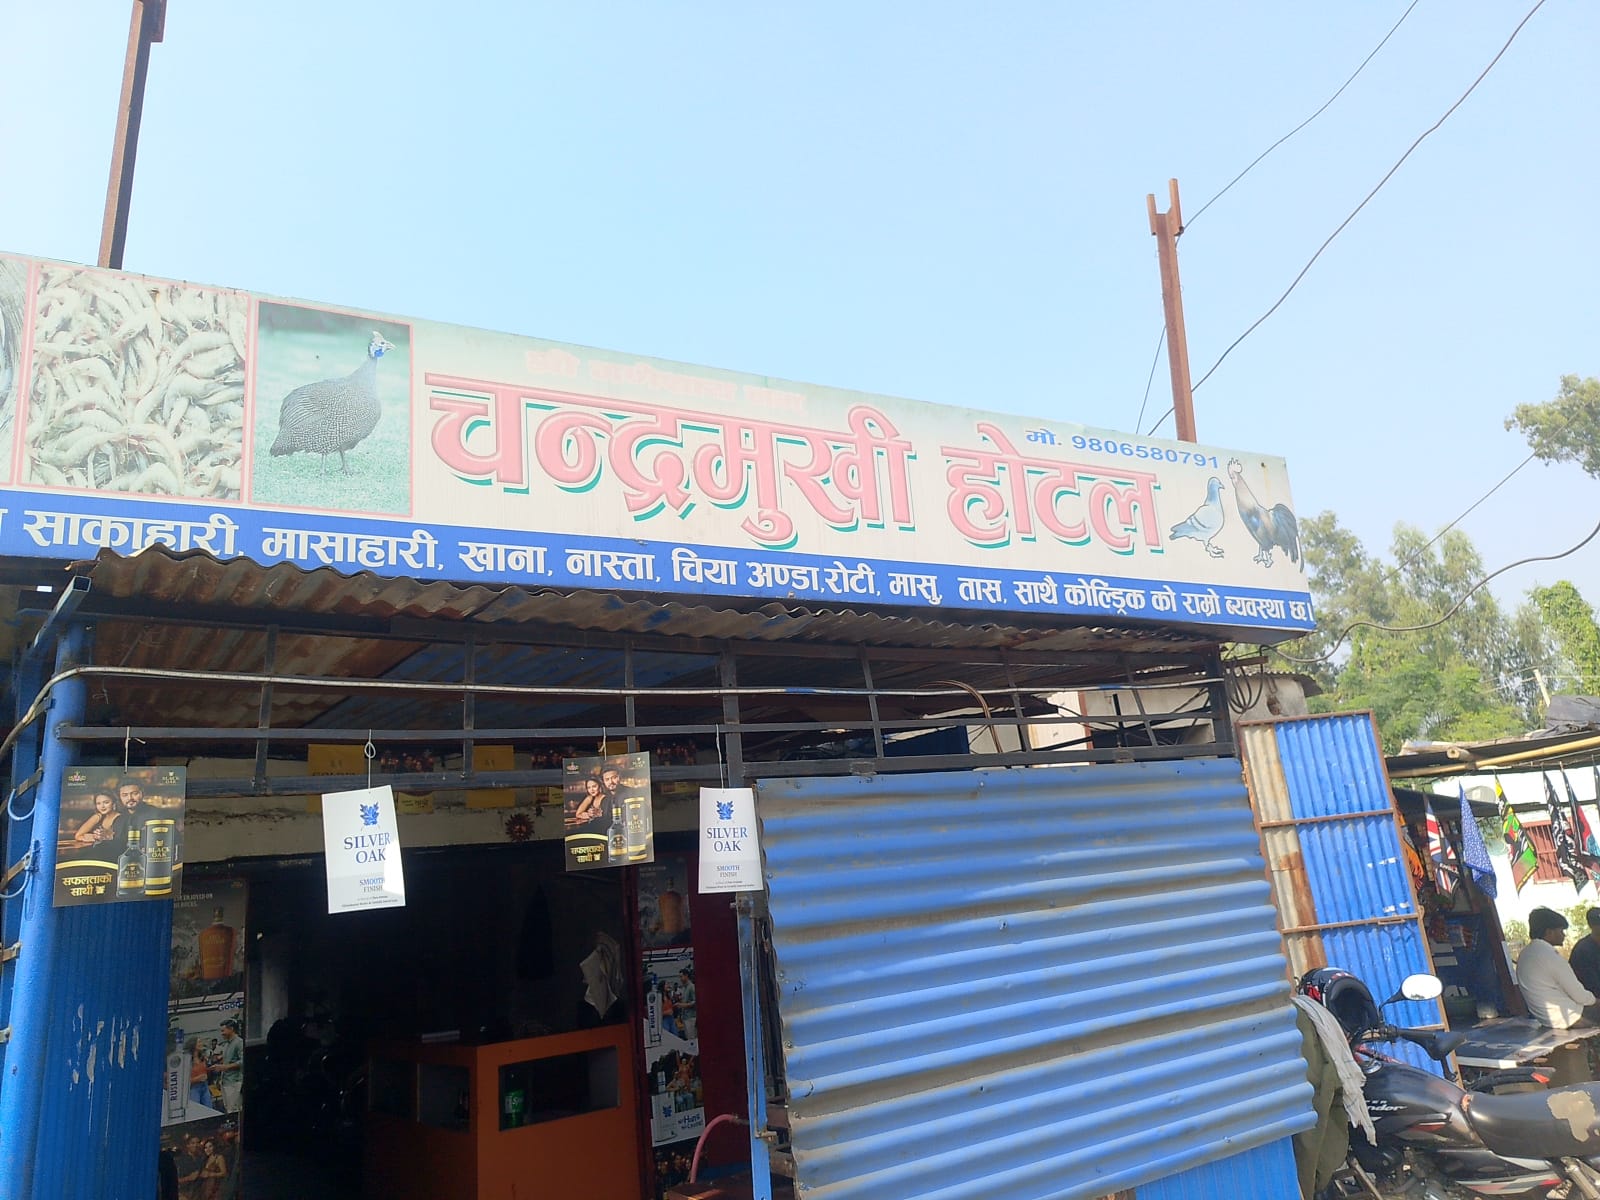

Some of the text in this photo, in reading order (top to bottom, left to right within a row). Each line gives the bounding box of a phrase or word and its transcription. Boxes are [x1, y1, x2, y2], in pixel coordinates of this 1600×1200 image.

[1071, 435, 1219, 469] 9806580791
[425, 372, 1163, 555] चन्द्रमुखी होटल
[262, 527, 444, 571] मासाहारी,
[458, 541, 553, 577] खाना,
[565, 548, 660, 583] नास्ता,
[671, 547, 738, 585] चिया
[957, 577, 1007, 604] तास,
[1013, 575, 1058, 604] साथै
[1150, 585, 1177, 612] को
[1181, 588, 1221, 617] राम्रो
[1224, 596, 1286, 619] व्यवस्था
[344, 832, 391, 850] SILVER
[706, 827, 748, 839] SILVER
[714, 840, 741, 852] OAK
[355, 848, 386, 864] OAK
[62, 872, 113, 886] सफलताको
[70, 886, 93, 897] साथी
